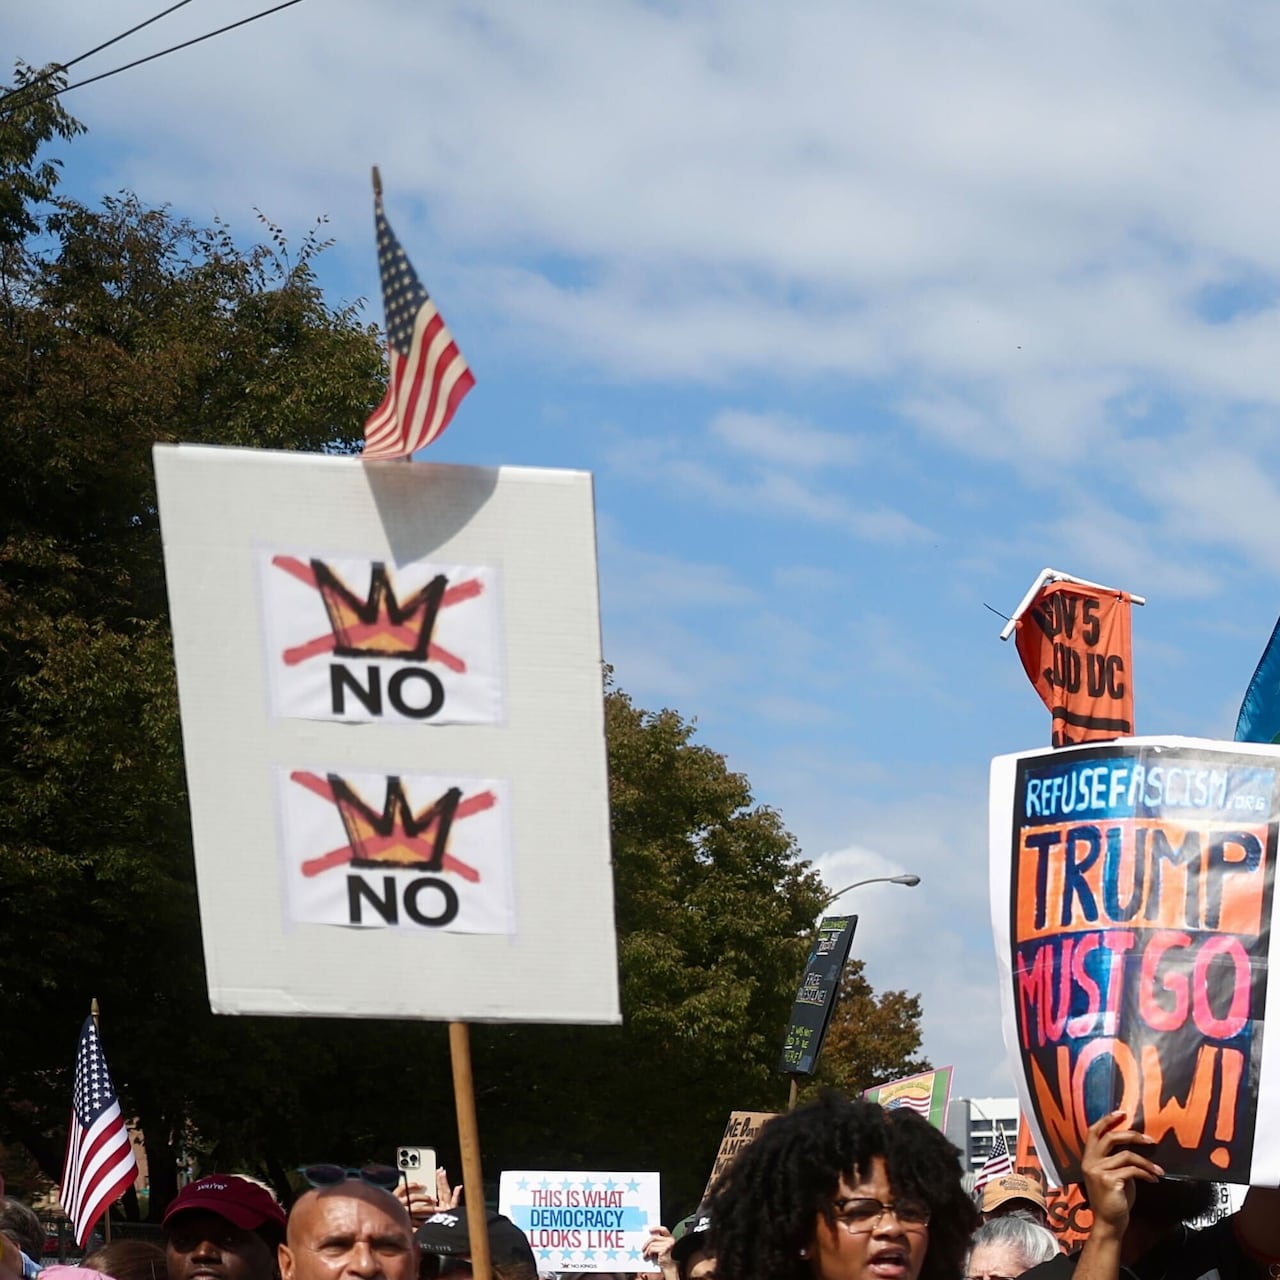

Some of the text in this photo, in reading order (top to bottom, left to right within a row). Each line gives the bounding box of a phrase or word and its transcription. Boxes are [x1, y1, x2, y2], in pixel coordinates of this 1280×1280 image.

[1082, 599, 1101, 647] 5
[330, 665, 446, 719] NO
[1087, 651, 1125, 699] DC
[347, 877, 460, 928] NO
[1024, 824, 1263, 932] TRUMP
[1016, 930, 1252, 1050] MUST GO
[1028, 1036, 1245, 1170] NOW!
[529, 1209, 625, 1229] DEMOCRACY
[531, 1190, 625, 1208] THIS IS WHAT
[529, 1229, 625, 1249] LOOKS LIKE
